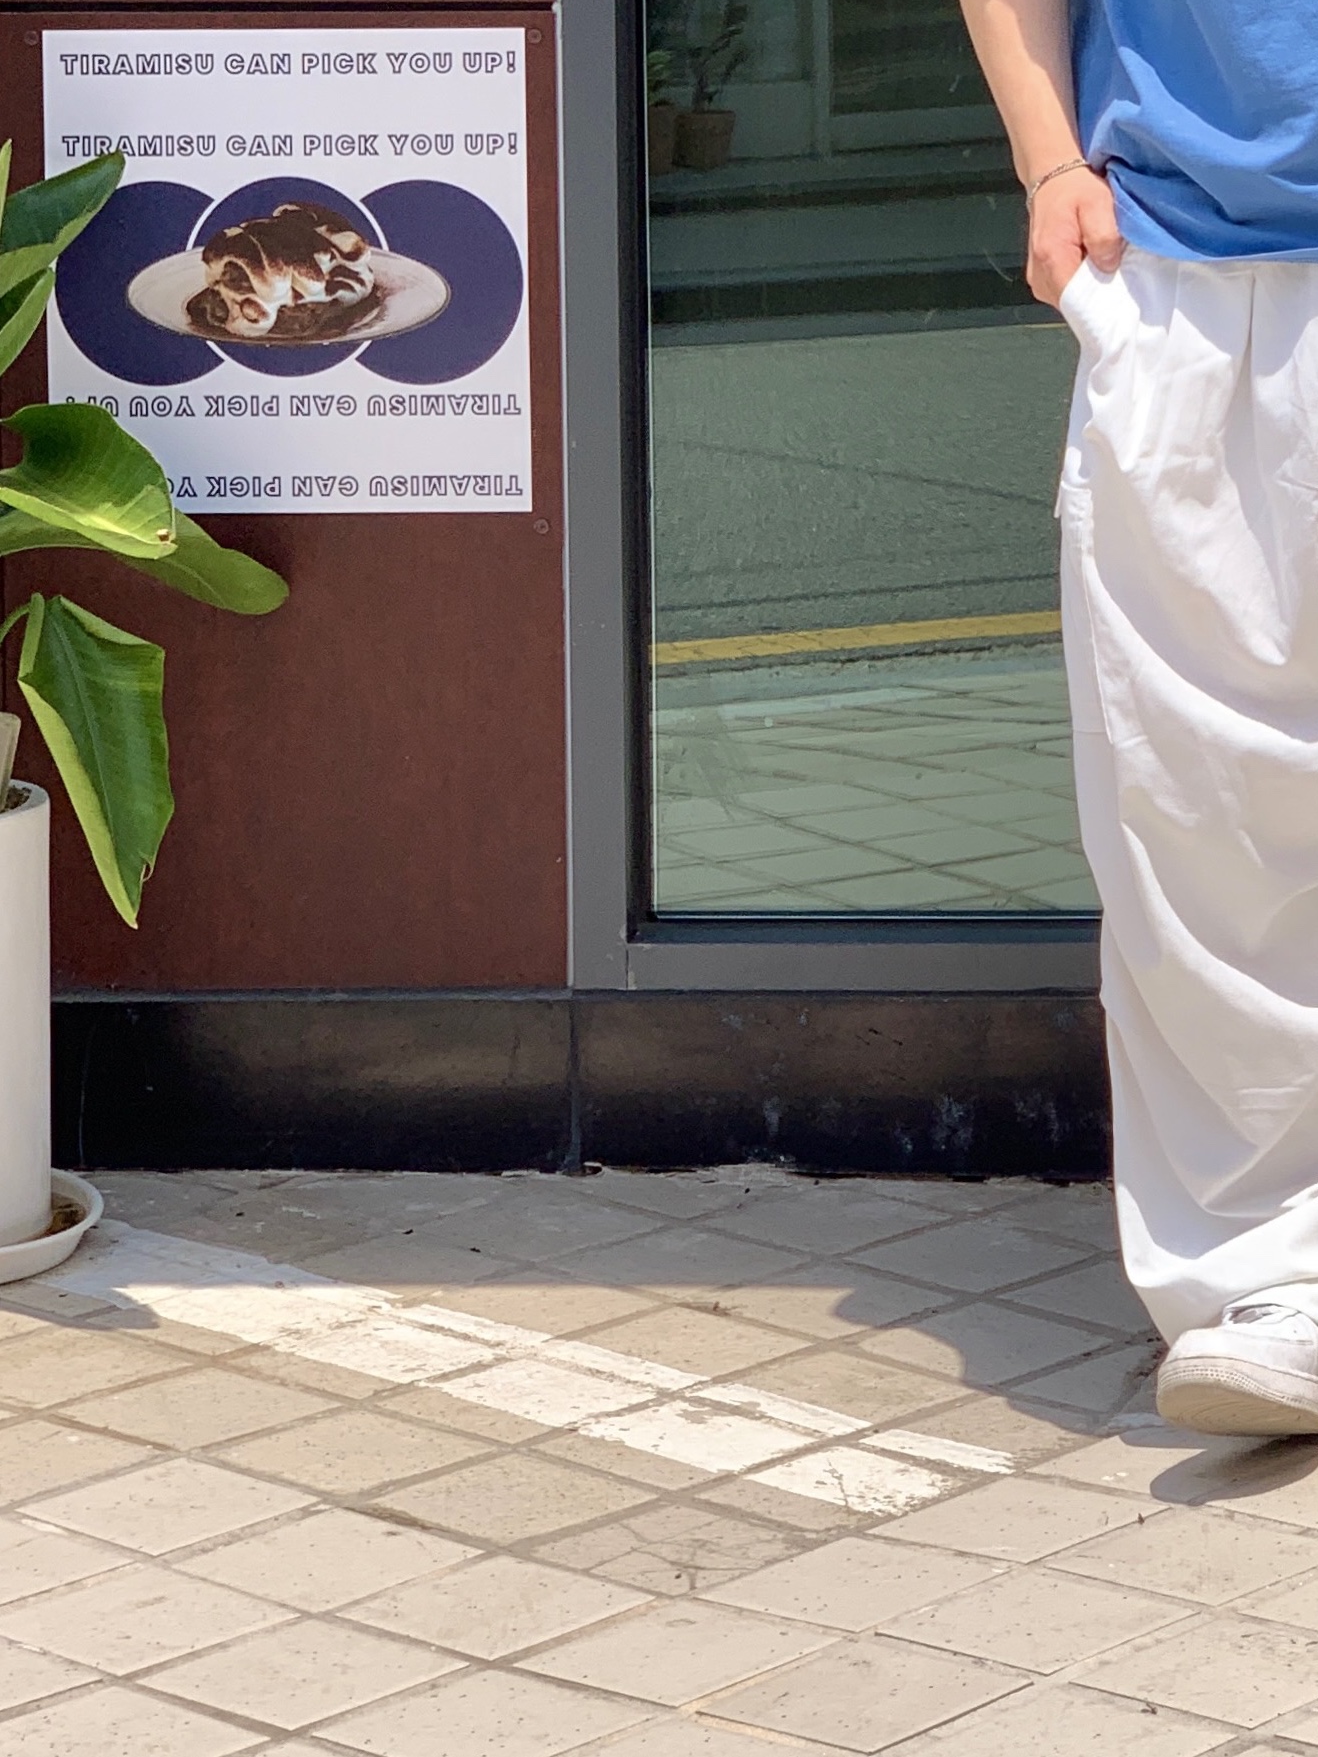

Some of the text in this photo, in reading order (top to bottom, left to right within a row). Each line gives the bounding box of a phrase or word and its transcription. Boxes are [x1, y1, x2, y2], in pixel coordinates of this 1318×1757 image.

[60, 51, 516, 75] TIRAMISU CAN PICK YOU UP!
[62, 132, 518, 157] TIRAMISU CAN PICK YOU UP!
[130, 395, 196, 417] YOU
[205, 395, 280, 417] PICK
[290, 395, 357, 417] CAN
[367, 394, 521, 416] TIRAMISU
[206, 476, 282, 498] PICK
[292, 475, 359, 497] CAN
[369, 475, 523, 496] TIRAMISU
